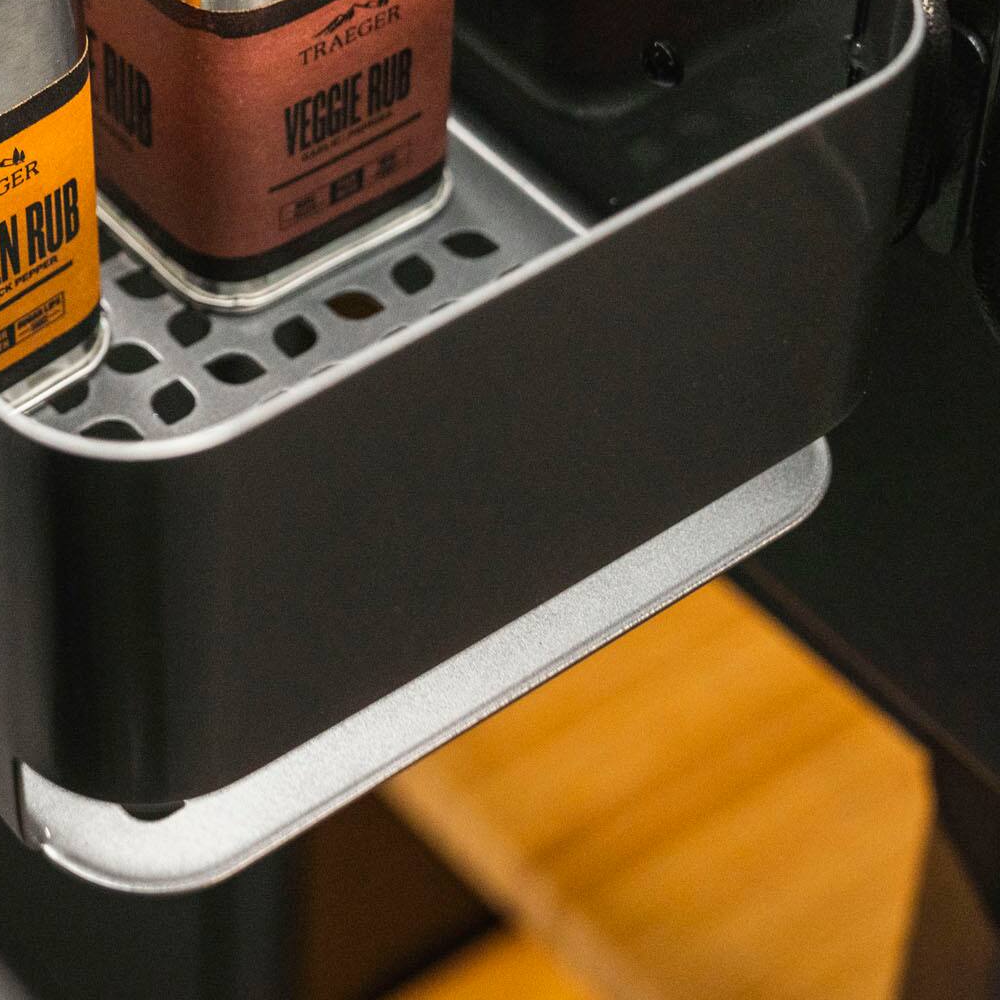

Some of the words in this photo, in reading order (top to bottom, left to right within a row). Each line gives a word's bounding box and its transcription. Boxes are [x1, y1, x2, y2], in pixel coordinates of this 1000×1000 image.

[298, 4, 402, 66] TRAEGER
[103, 41, 153, 149] RUB
[284, 72, 363, 157] VEGGIE
[367, 46, 413, 117] RUB
[25, 177, 80, 266] RUB
[14, 255, 59, 287] PEPPER
